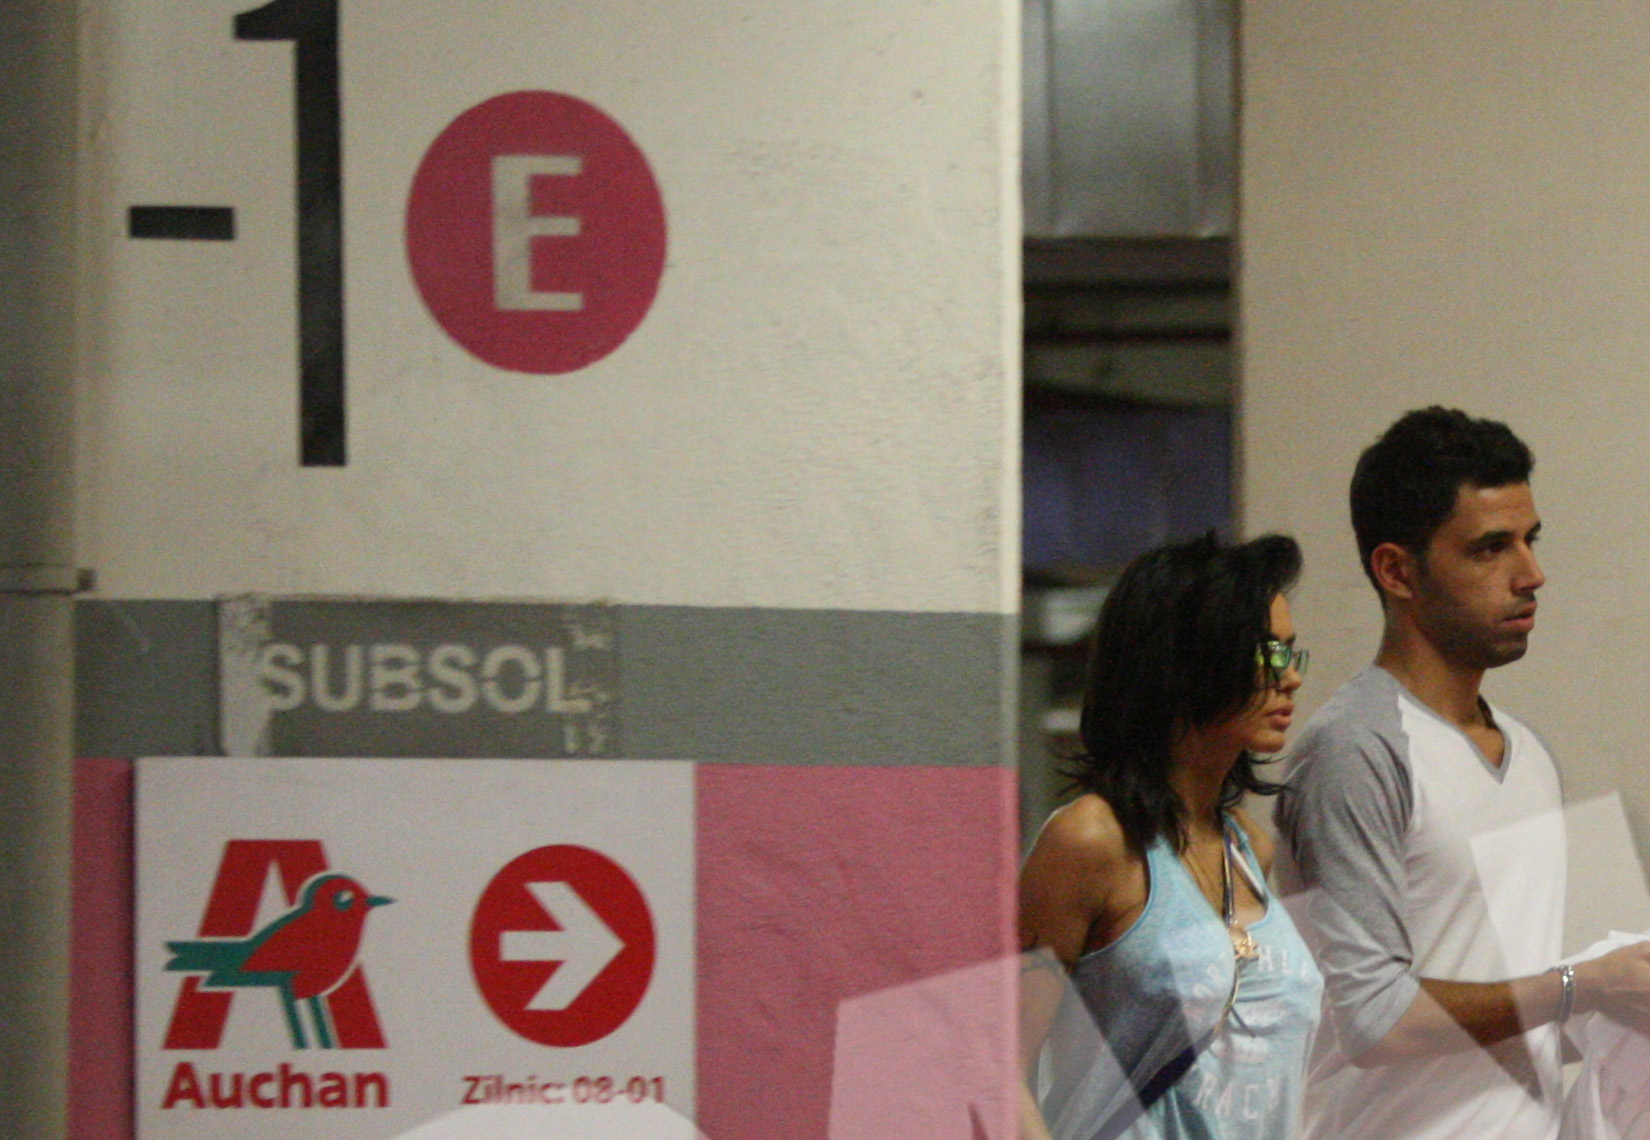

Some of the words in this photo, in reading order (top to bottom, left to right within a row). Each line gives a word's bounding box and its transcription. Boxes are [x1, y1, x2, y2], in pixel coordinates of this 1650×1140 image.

[129, 0, 347, 467] -1
[490, 154, 584, 311] E
[262, 644, 592, 713] SUBSOL
[161, 1062, 390, 1110] Auchan
[461, 1075, 566, 1105] Zilnic:
